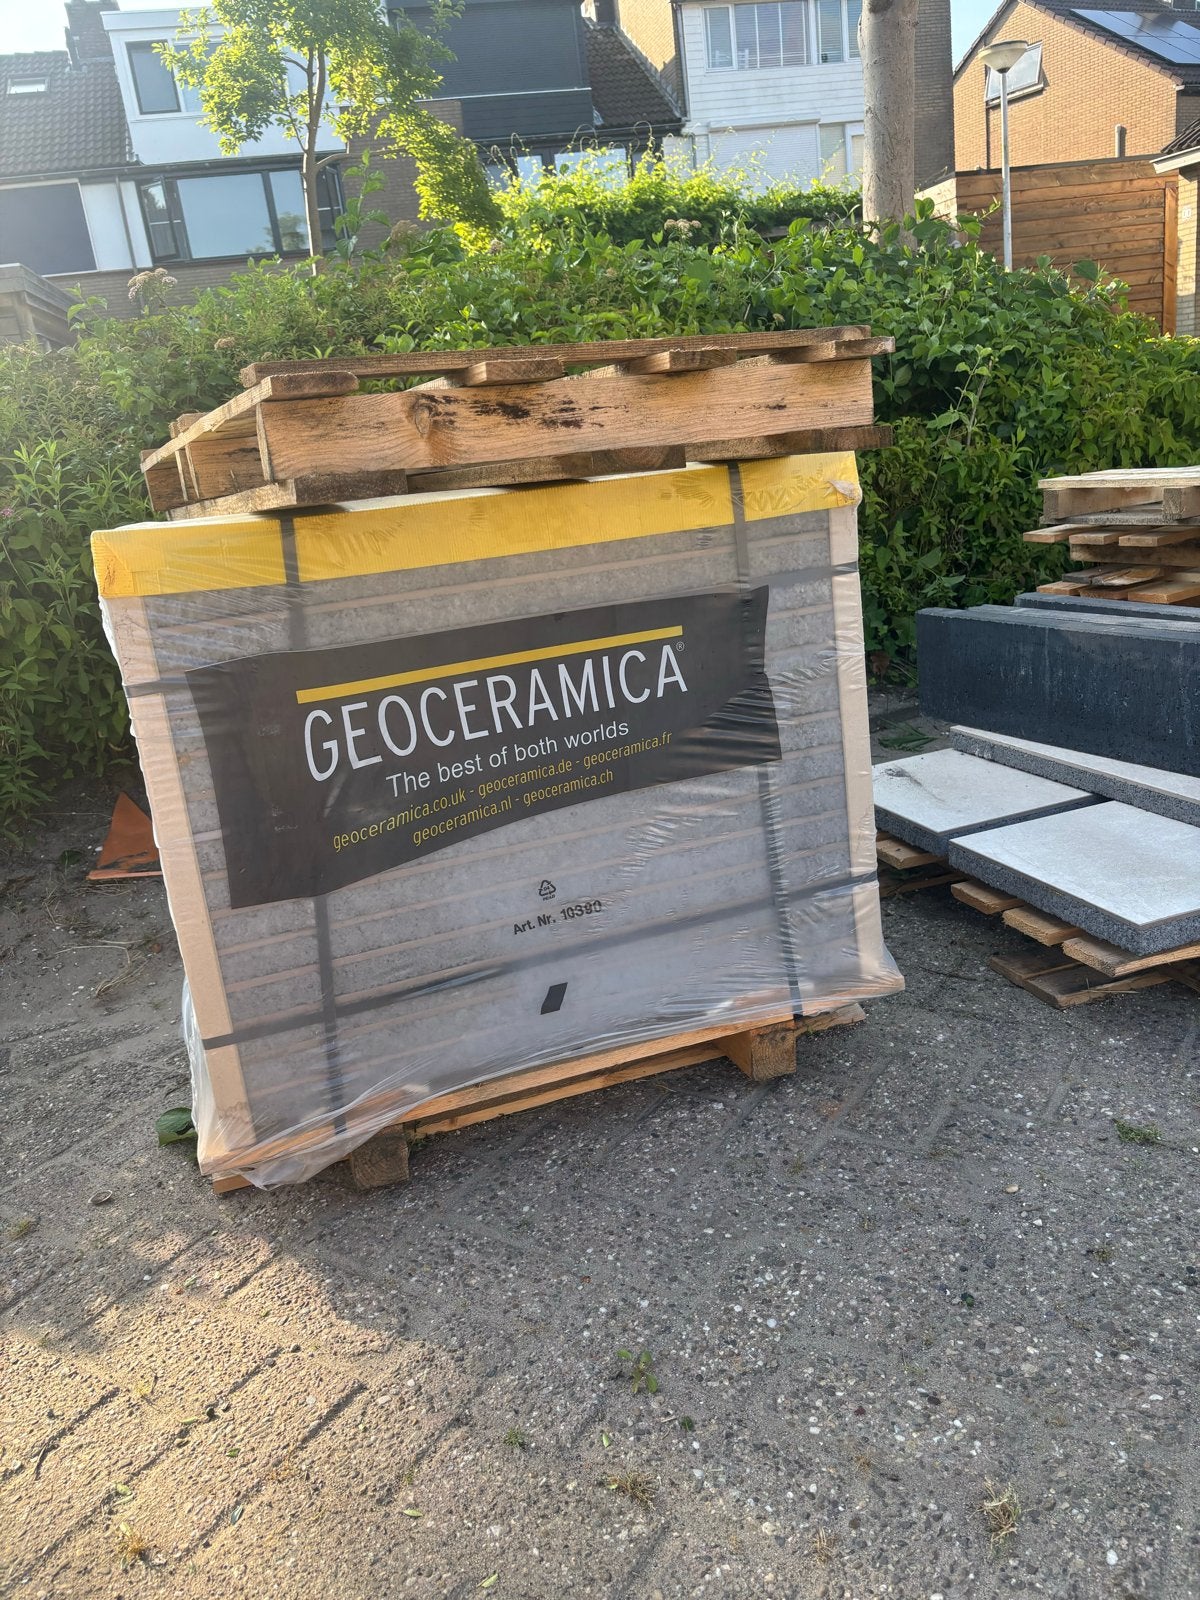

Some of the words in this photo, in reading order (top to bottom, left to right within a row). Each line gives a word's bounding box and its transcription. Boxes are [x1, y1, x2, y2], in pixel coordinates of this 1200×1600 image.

[332, 787, 467, 853] geoceramica.co.uk
[477, 758, 573, 800] geoceramica.de
[583, 730, 673, 770] geoceramica.fr
[385, 770, 431, 798] The
[437, 753, 483, 783] best
[488, 745, 508, 768] of
[514, 736, 558, 762] both
[563, 720, 629, 749] worlds
[412, 795, 512, 847] geoceramica.nl
[523, 768, 614, 807] geoceramica.ch
[513, 919, 536, 935] Art.
[537, 913, 556, 927] Nr.
[560, 900, 602, 920] 10390
